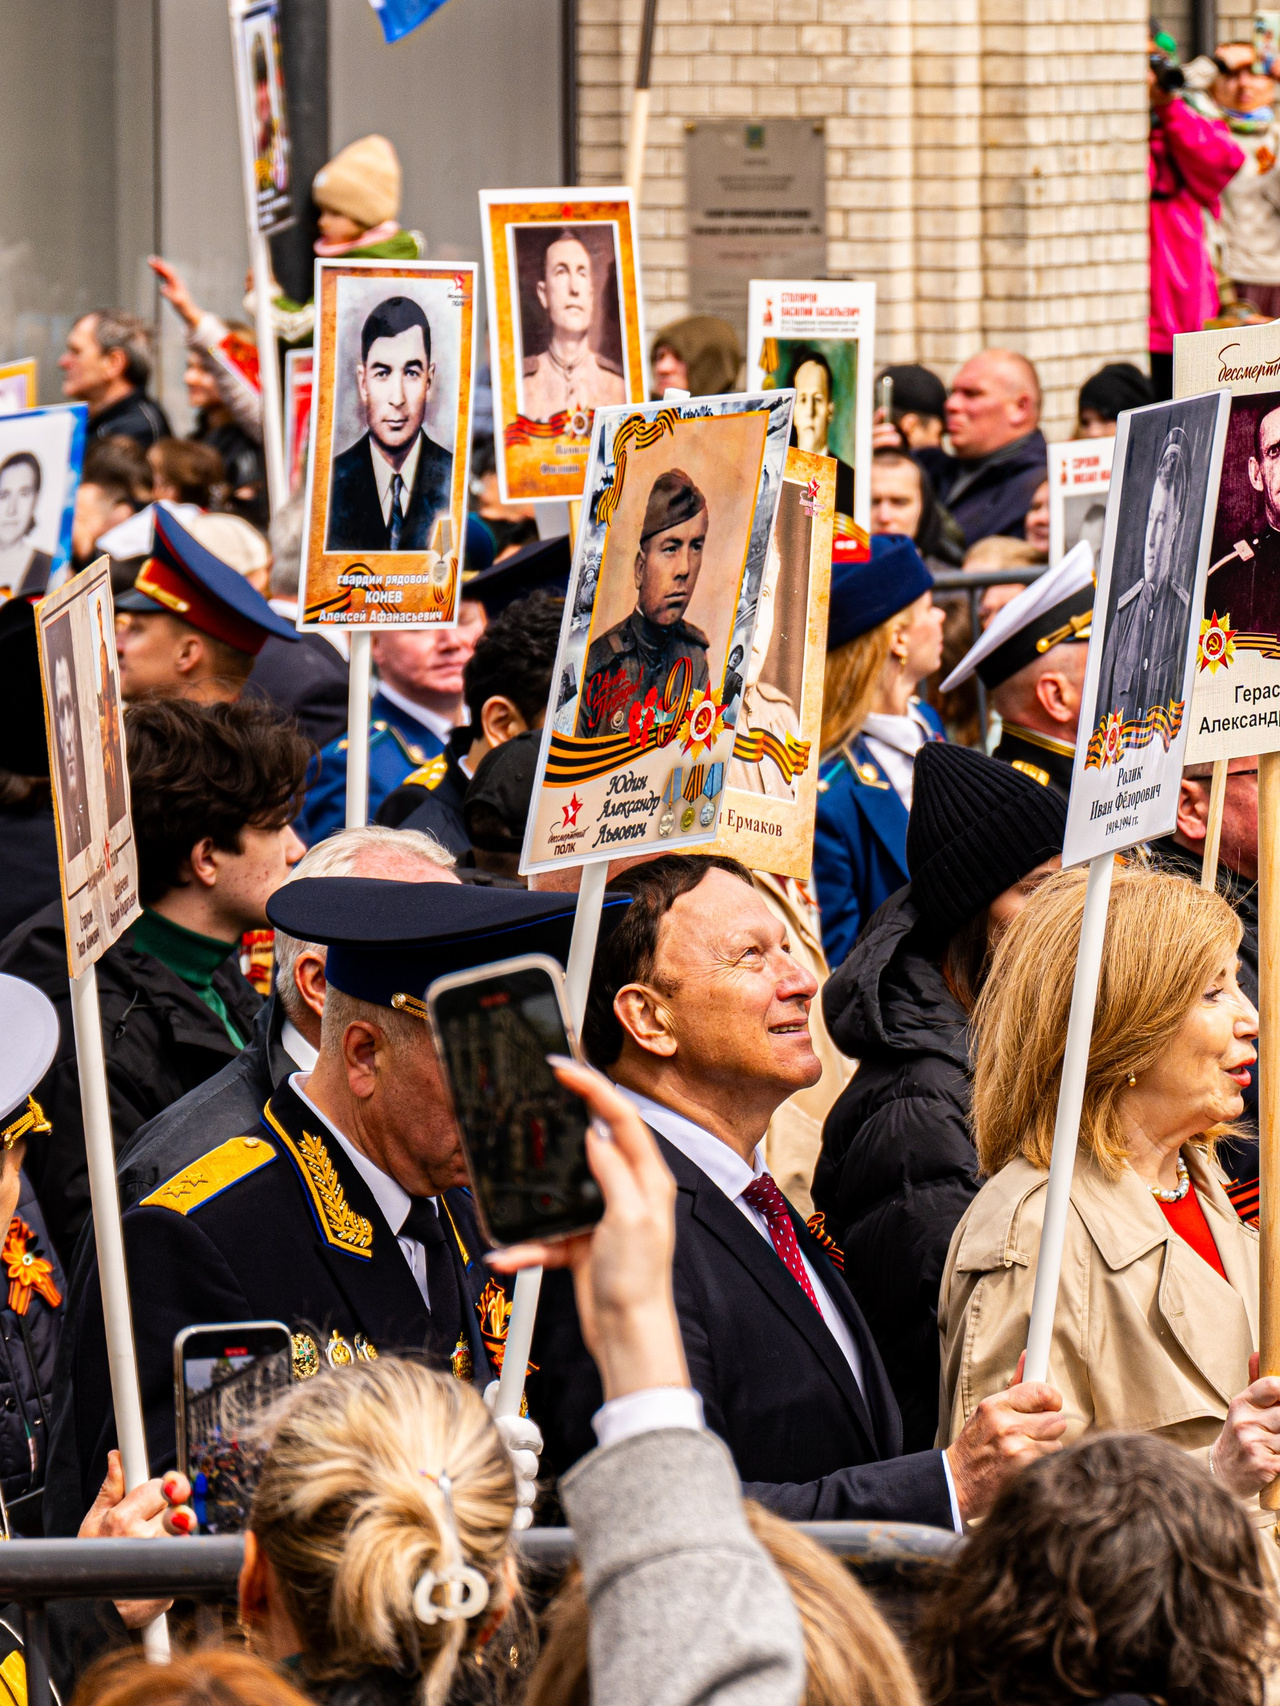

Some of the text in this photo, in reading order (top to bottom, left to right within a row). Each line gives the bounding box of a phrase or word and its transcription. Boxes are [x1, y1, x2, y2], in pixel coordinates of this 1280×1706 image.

[337, 572, 429, 587] гвардии рядовой
[365, 590, 403, 604] КОНЕВ
[318, 610, 443, 623] Алексей Афанасьевич
[606, 771, 649, 796] Юдин
[1116, 766, 1143, 787] Ролик
[596, 790, 661, 822] Александр
[1089, 783, 1161, 821] Иван Фёдорович
[591, 822, 648, 848] Львович
[727, 808, 783, 837] Ермаков
